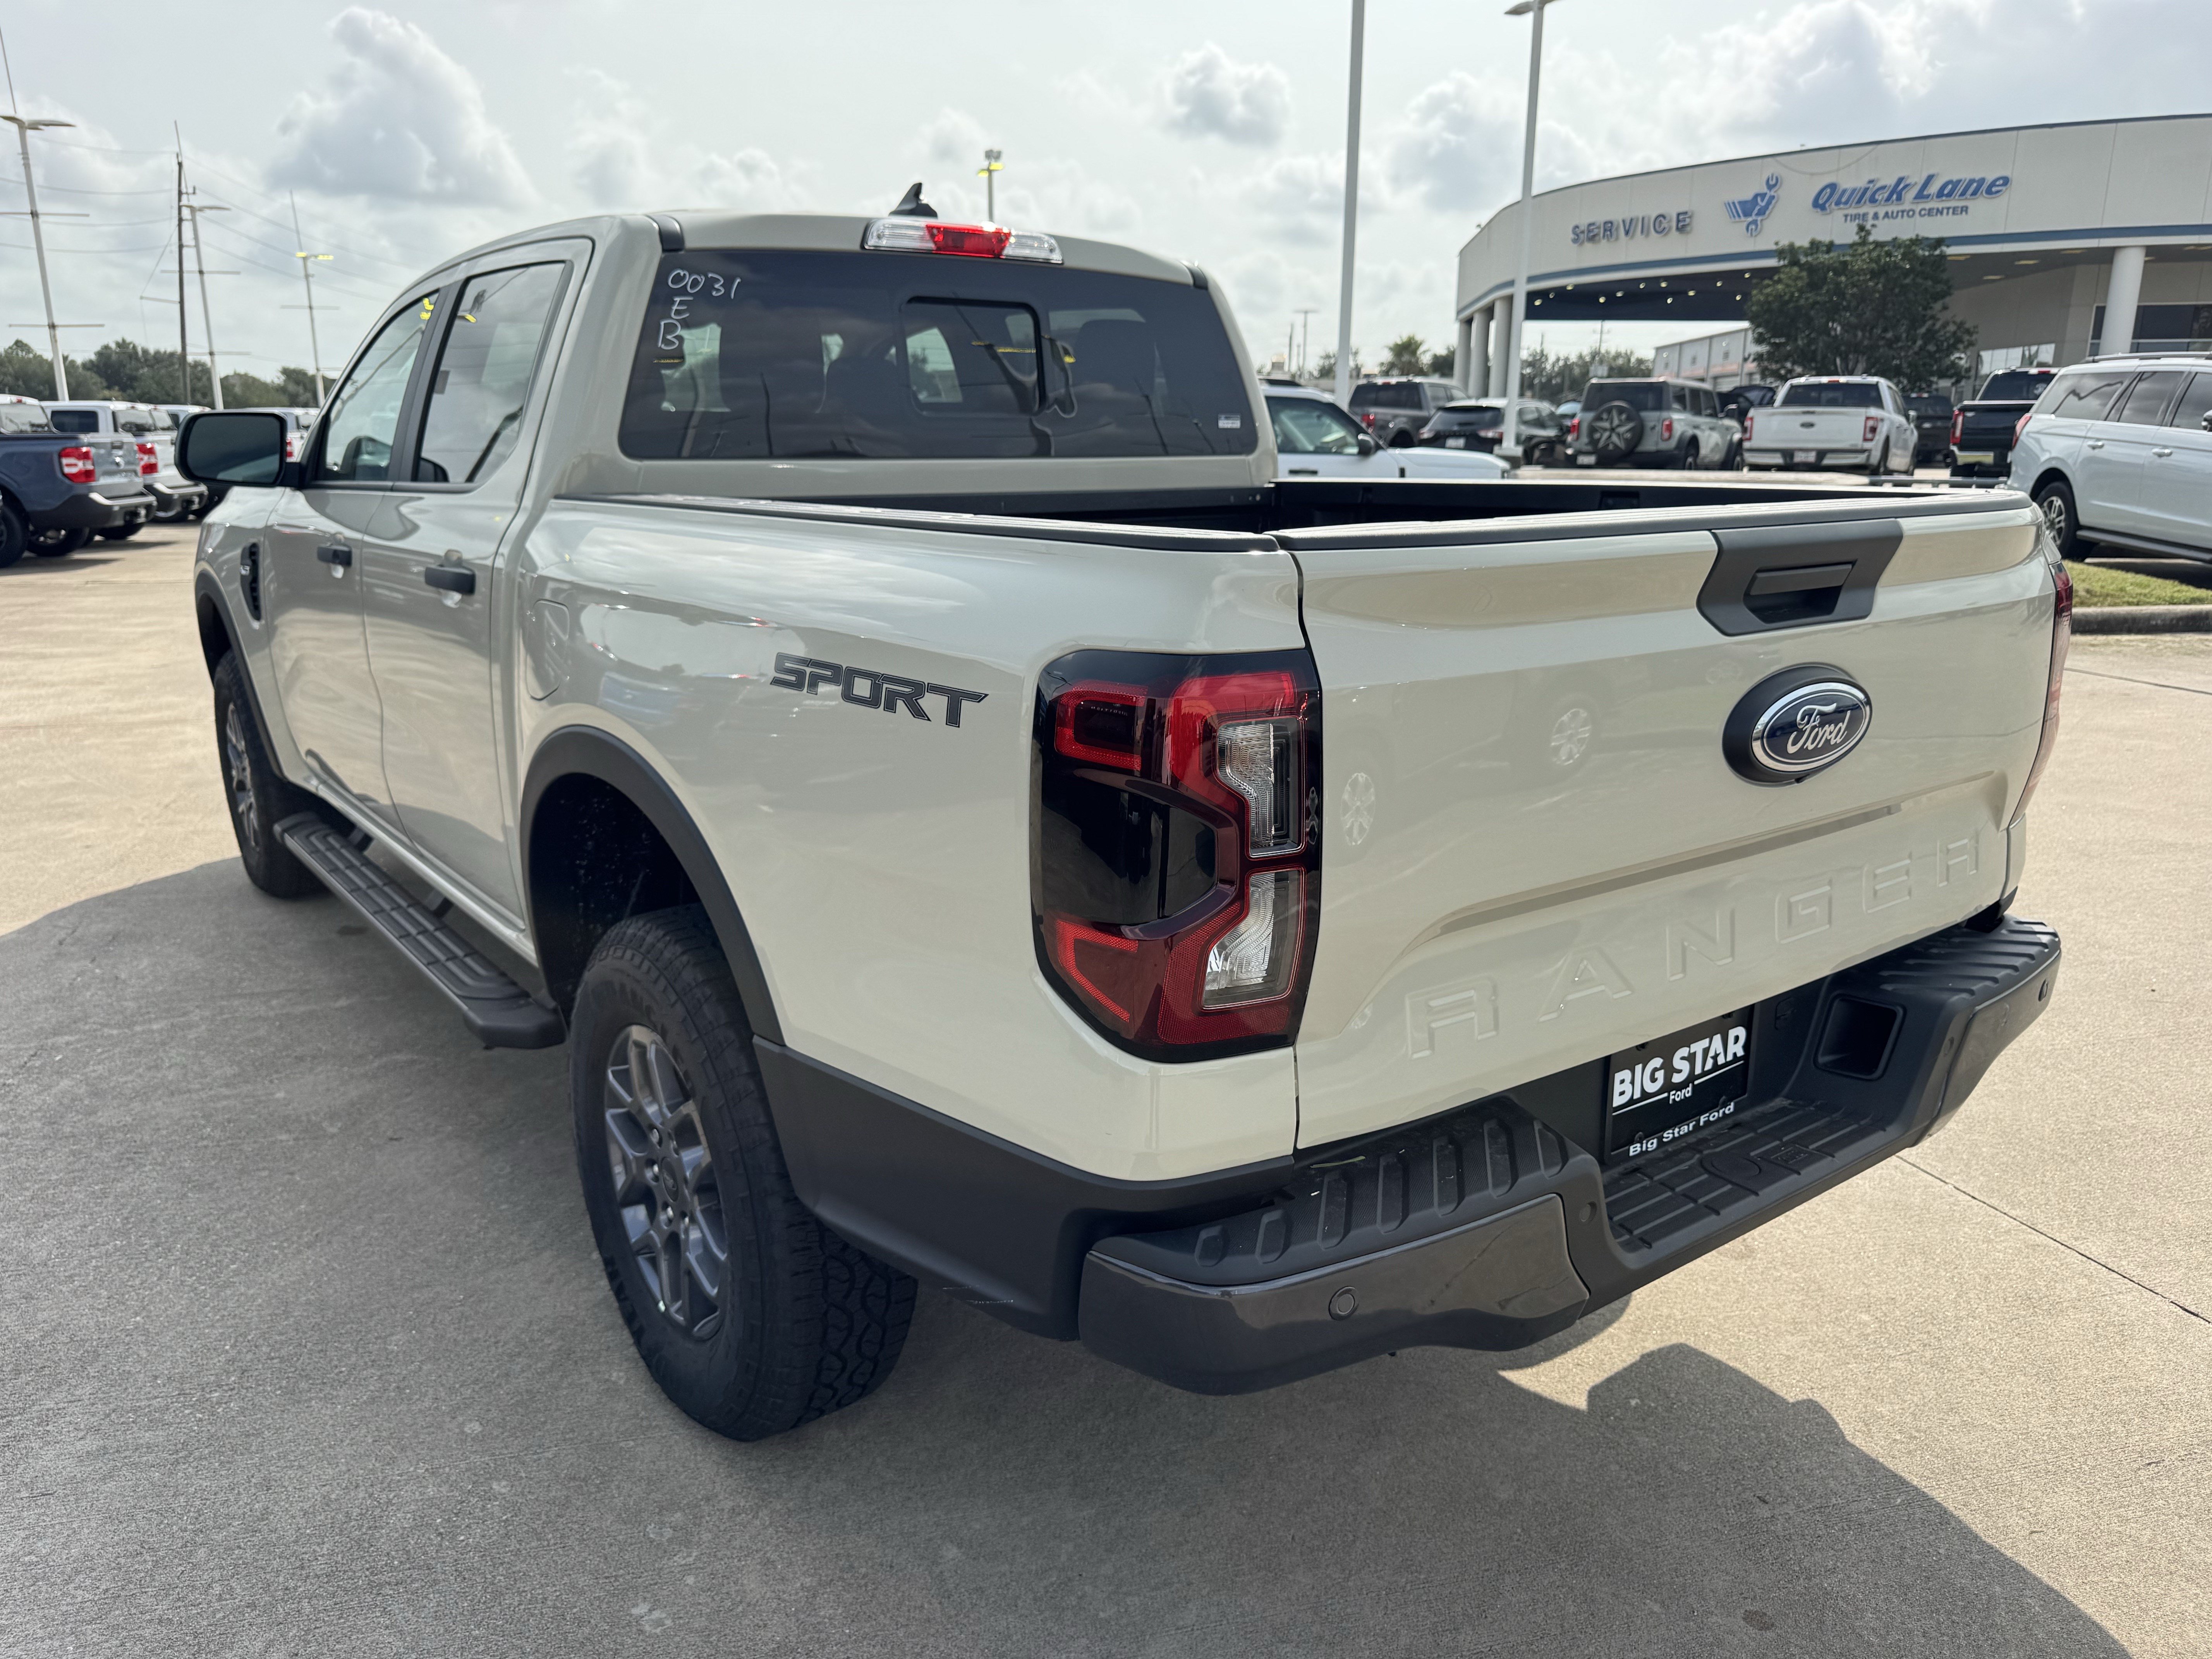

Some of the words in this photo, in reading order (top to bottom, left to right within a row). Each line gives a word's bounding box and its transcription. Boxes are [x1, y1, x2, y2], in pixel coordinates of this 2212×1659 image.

[1811, 175, 1915, 213] Quick
[1913, 173, 2011, 201] Lane
[1571, 211, 1692, 245] SERVICE
[1843, 212, 1868, 223] TIRE
[1872, 212, 1879, 221] &
[1882, 208, 1915, 220] AUTO
[1918, 205, 1969, 218] CENTER
[668, 268, 741, 299] 0031
[670, 295, 694, 319] E
[658, 319, 681, 350] B
[770, 652, 989, 728] SPORT
[1787, 703, 1851, 754] Ford
[1405, 830, 1980, 1059] RANGER
[1613, 1057, 1664, 1108] BIG
[1671, 1026, 1747, 1083] STAR
[1669, 1084, 1693, 1104] Ford
[1629, 1138, 1658, 1156] Big
[1663, 1121, 1695, 1142] Star
[1699, 1102, 1735, 1126] Ford
